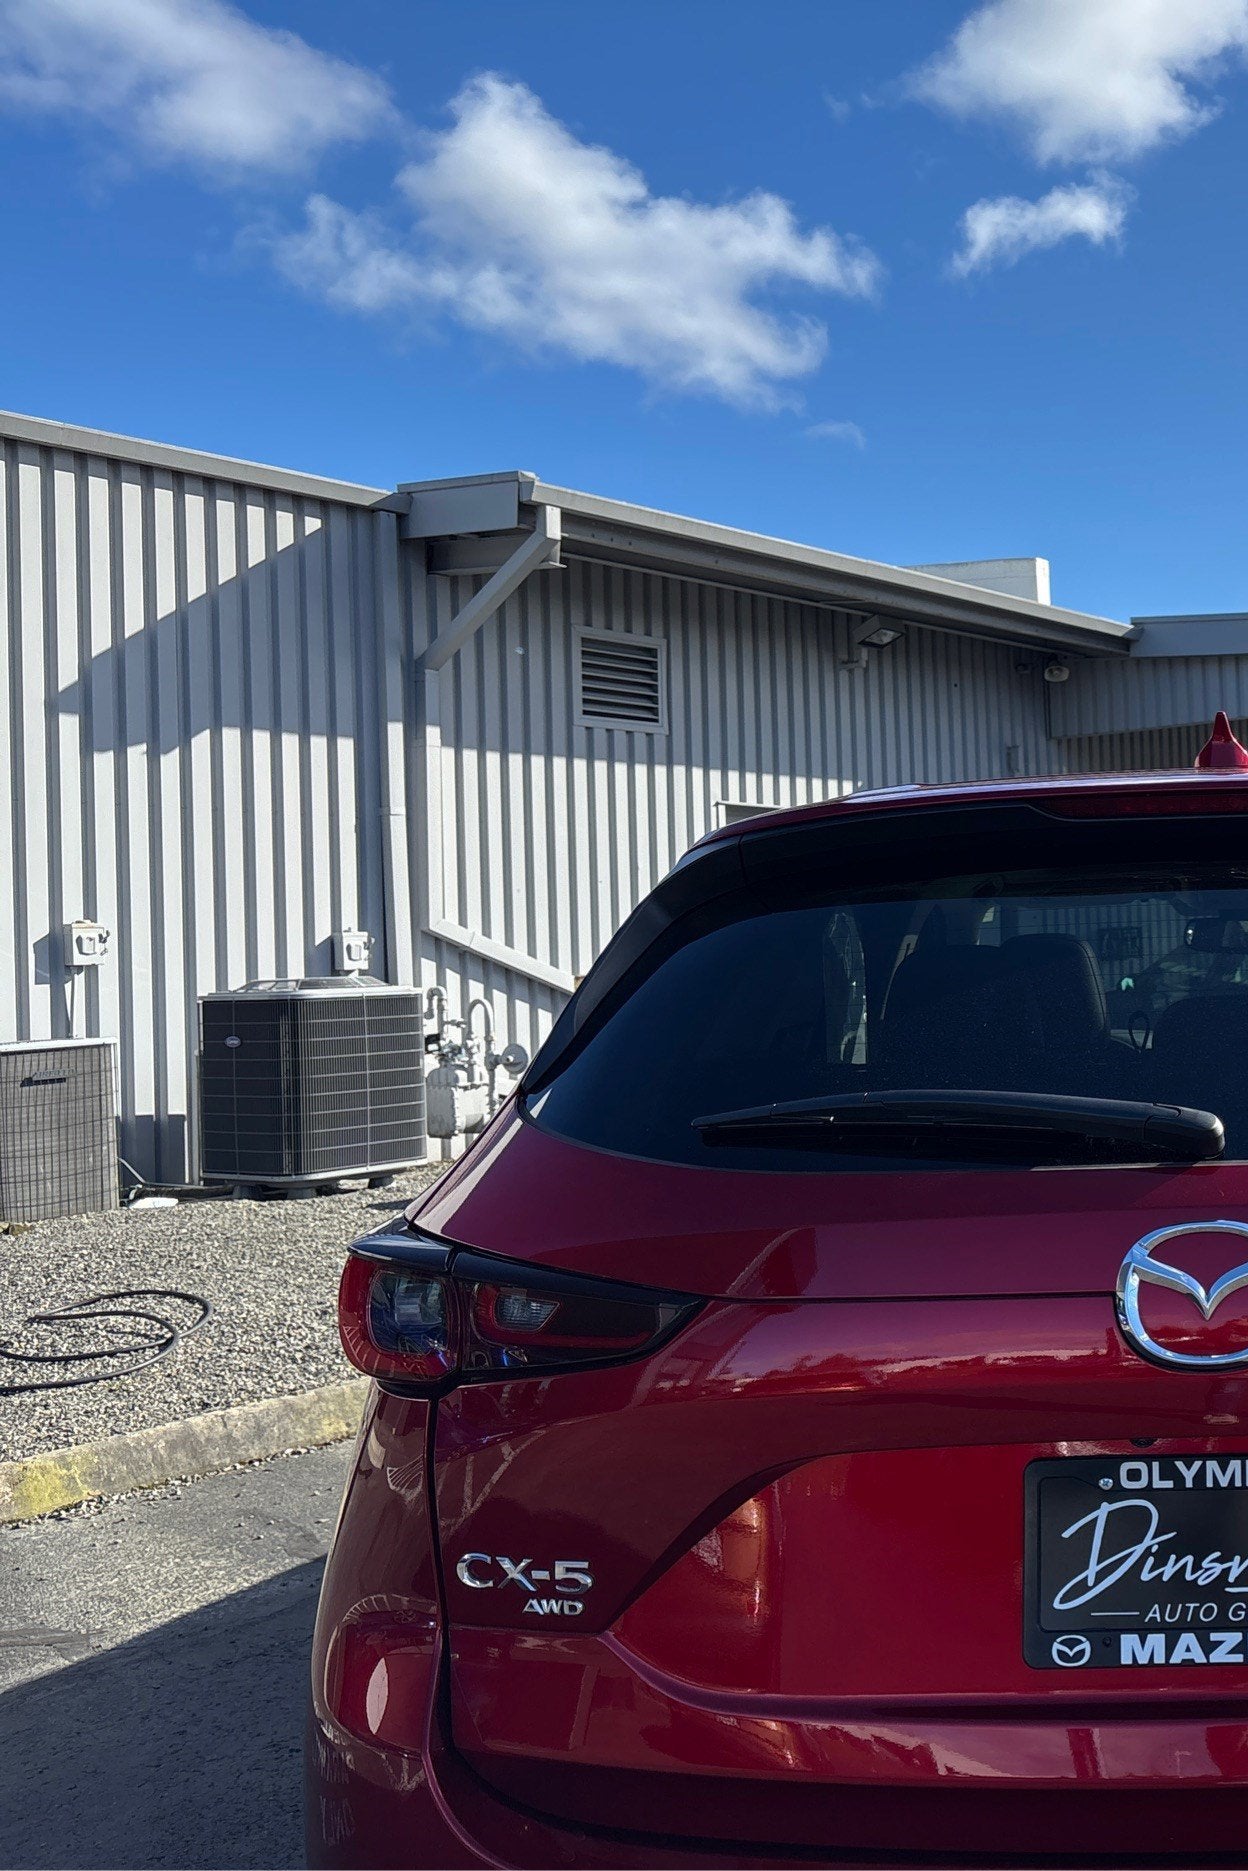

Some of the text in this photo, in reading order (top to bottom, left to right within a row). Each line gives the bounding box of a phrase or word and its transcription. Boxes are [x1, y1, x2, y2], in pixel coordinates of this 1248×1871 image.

[456, 1552, 595, 1595] CX-5
[521, 1598, 585, 1616] AWD
[1144, 1602, 1218, 1623] AUTO
